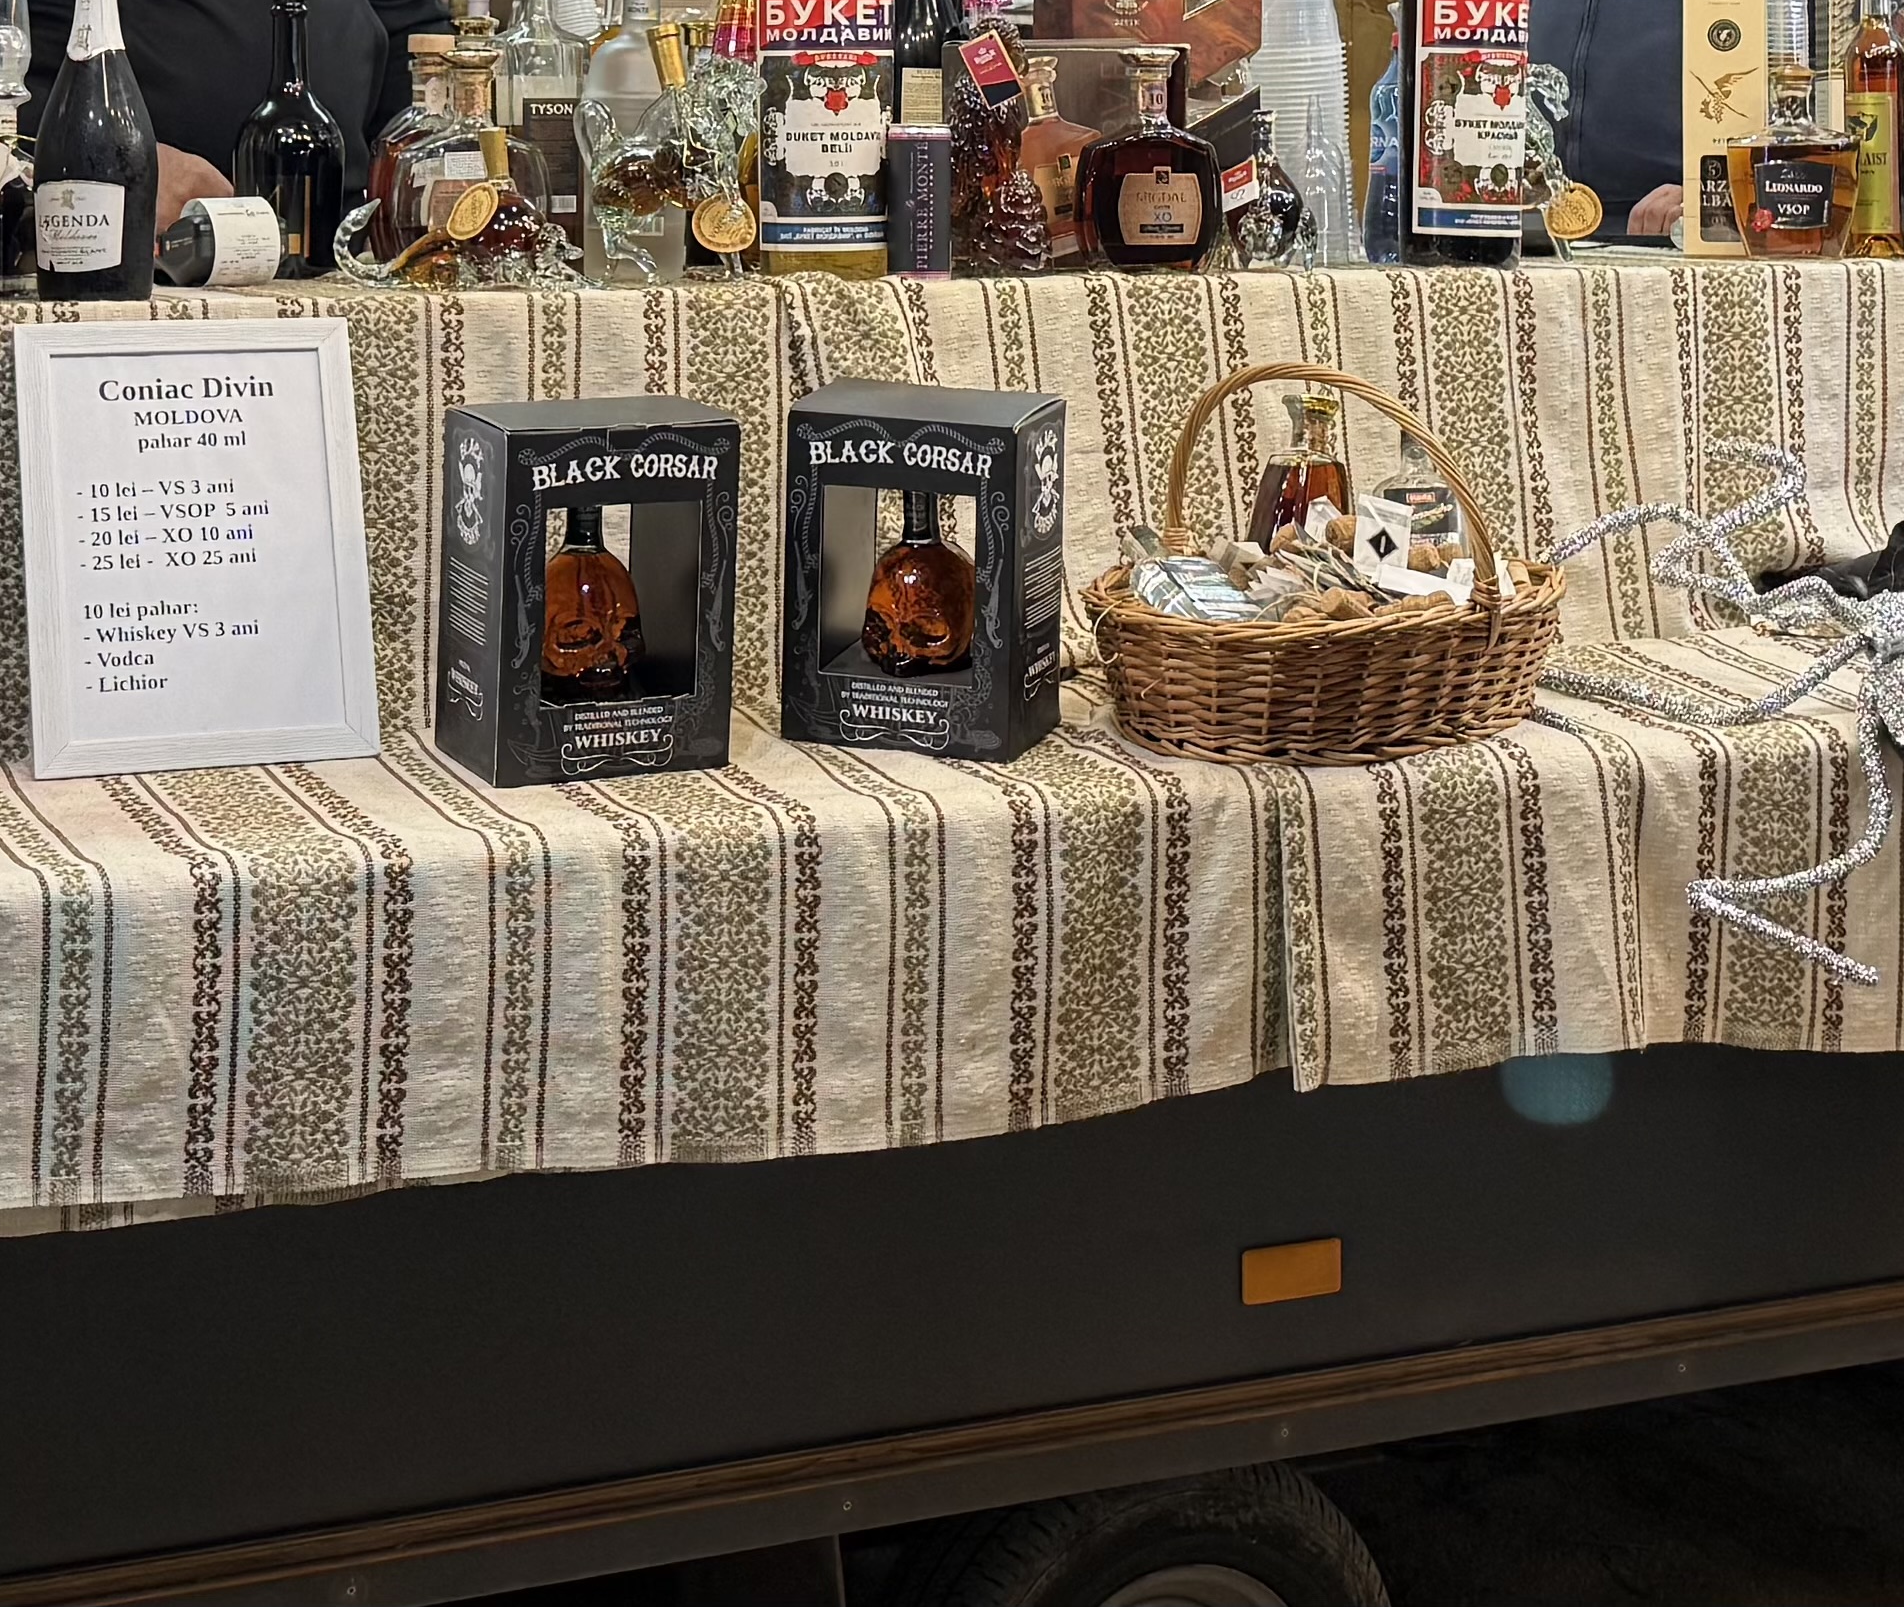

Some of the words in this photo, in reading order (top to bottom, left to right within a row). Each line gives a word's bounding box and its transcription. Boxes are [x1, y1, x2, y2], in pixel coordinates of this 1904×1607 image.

[530, 103, 573, 115] TYSON
[1777, 204, 1810, 216] VSOP
[98, 377, 194, 402] Coniac
[202, 375, 274, 399] Divin
[133, 408, 243, 427] MOLDOVA
[138, 432, 192, 454] pahar
[196, 432, 218, 447] 40
[223, 430, 246, 447] ml
[809, 439, 895, 465] BLACK
[903, 443, 992, 478] CORSAR
[532, 455, 622, 491] BLACK
[630, 454, 719, 480] CORSAR
[91, 483, 110, 499] 10
[115, 481, 137, 498] lei
[158, 480, 185, 496] VS
[191, 479, 201, 495] 3
[206, 481, 234, 494] ani
[91, 506, 111, 523] 15
[117, 505, 138, 522] lei
[159, 503, 216, 520] VSOP
[225, 502, 237, 517] 5
[242, 499, 269, 516] ani
[90, 530, 112, 547] 20
[118, 529, 139, 546] lei
[162, 527, 193, 544] XO
[201, 526, 220, 542] 10
[226, 523, 253, 540] ani
[92, 554, 114, 571] 25
[119, 553, 141, 570] lei
[165, 551, 196, 567] XO
[202, 550, 223, 565] 25
[229, 547, 257, 564] ani
[84, 604, 103, 620] 10
[109, 602, 131, 619] lei
[136, 600, 199, 622] pahar:
[96, 625, 177, 644] Whiskey
[182, 622, 209, 639] VS
[215, 621, 226, 637] 3
[231, 619, 259, 636] ani
[97, 650, 154, 668] Vodca
[99, 673, 169, 693] Lichior
[852, 704, 937, 724] WHISKEY
[574, 729, 662, 750] WHISKEY
